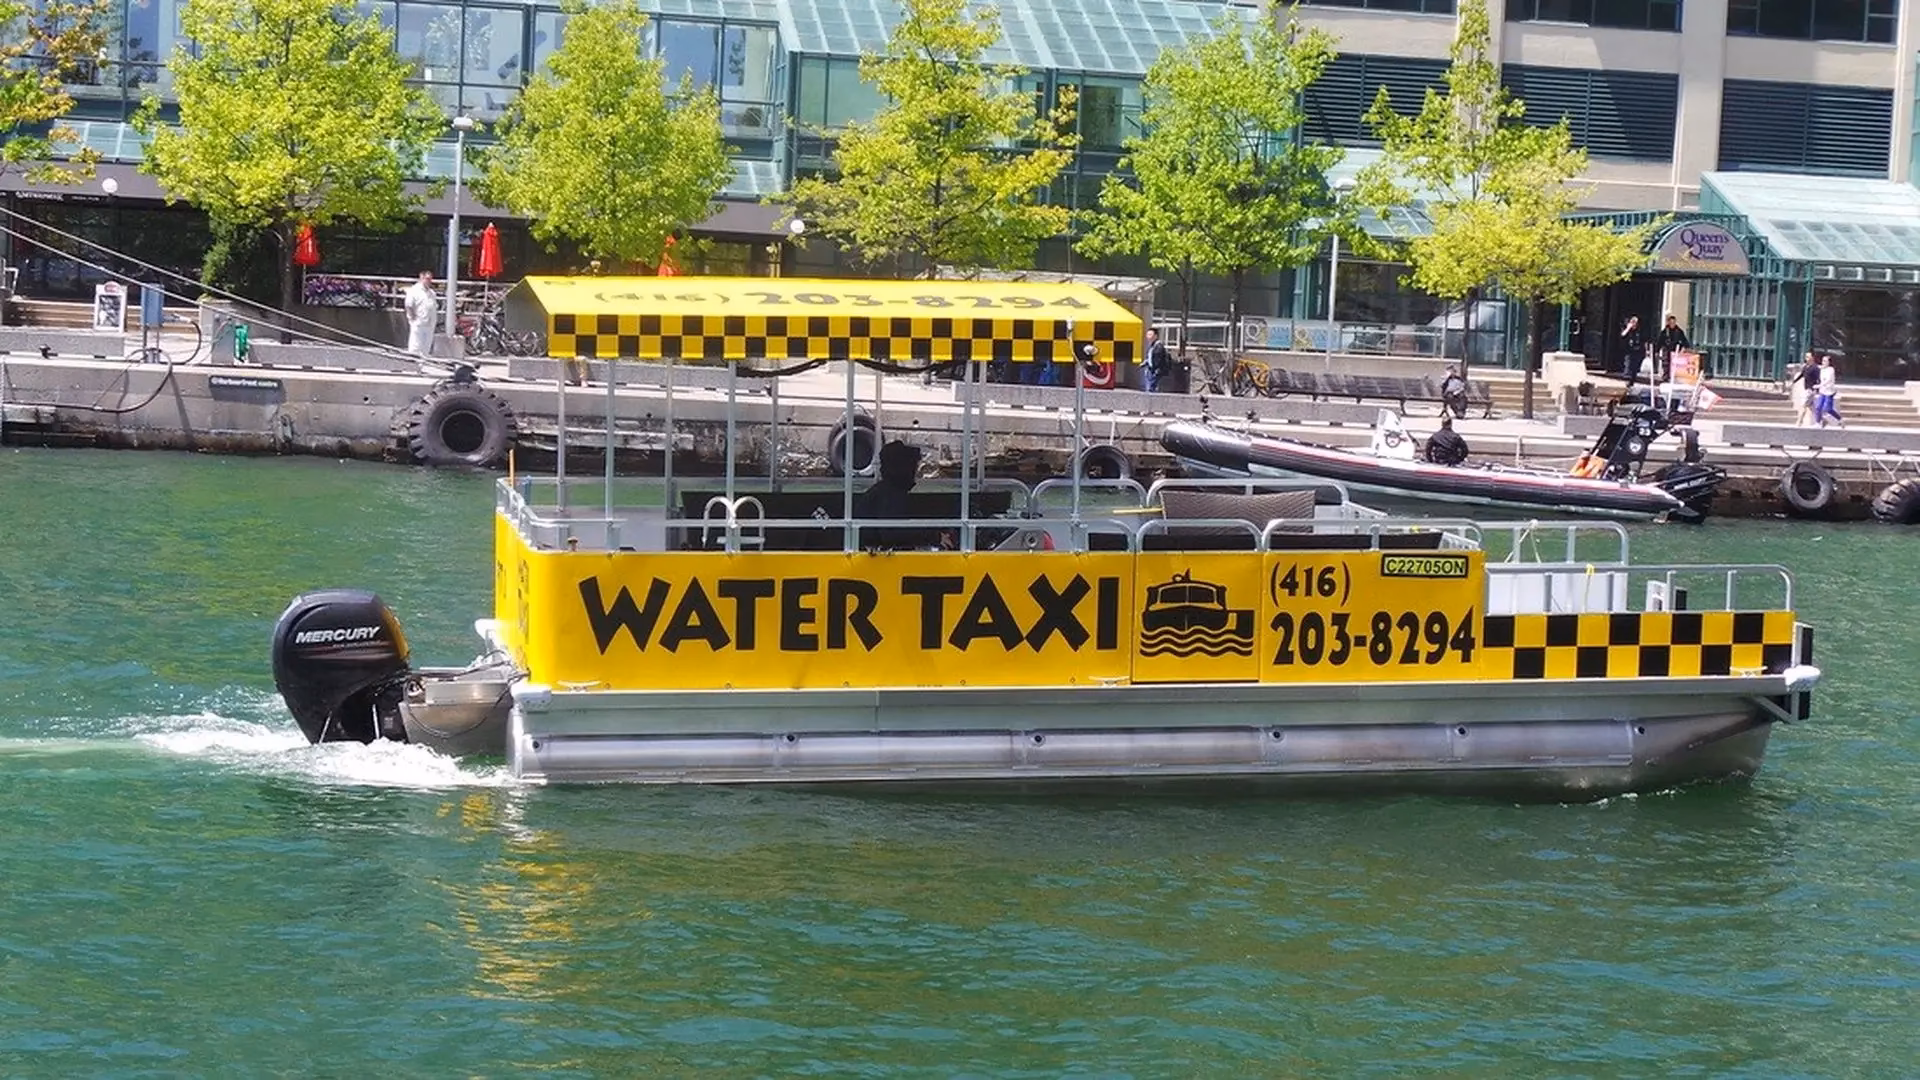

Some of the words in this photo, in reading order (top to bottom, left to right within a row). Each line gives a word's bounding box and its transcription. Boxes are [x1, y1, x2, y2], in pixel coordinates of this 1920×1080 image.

[744, 291, 1091, 309] 203-8294
[1386, 559, 1464, 574] C22705ON
[1271, 561, 1350, 607] (416)
[579, 576, 883, 655] WATER
[901, 572, 1120, 653] TAXI
[295, 626, 380, 644] MERCURY
[1270, 605, 1476, 666] 203-8294
